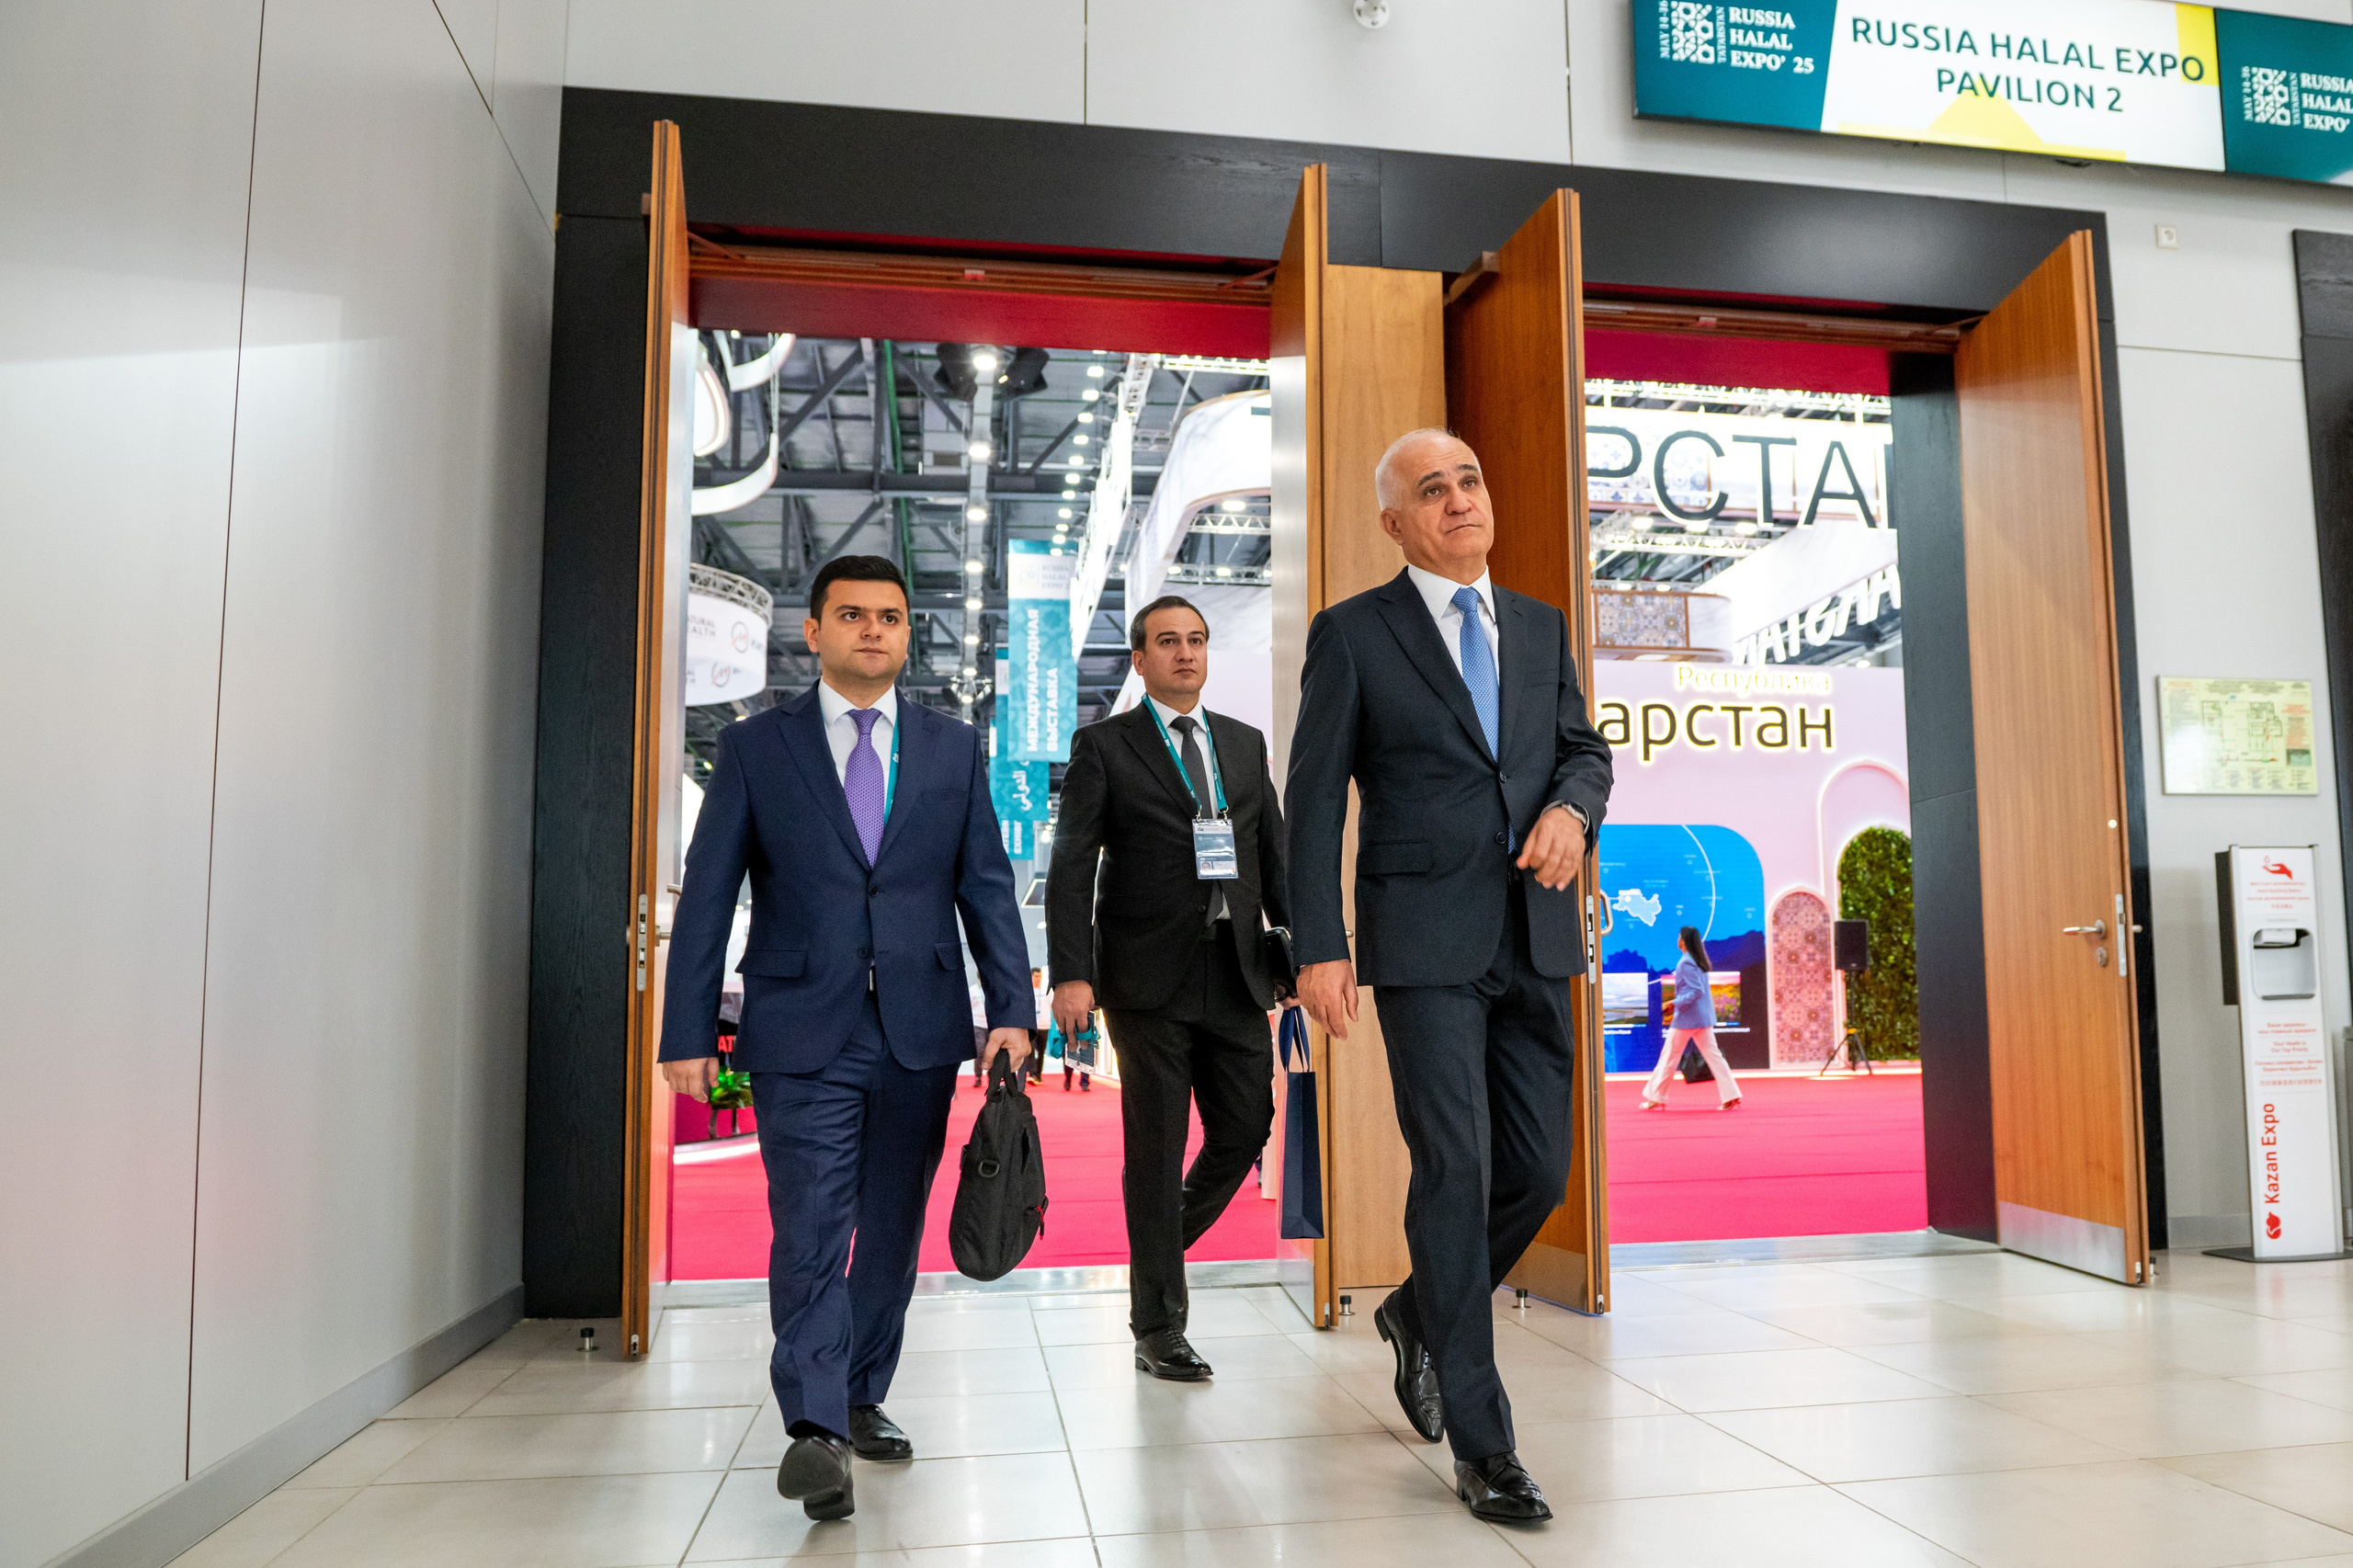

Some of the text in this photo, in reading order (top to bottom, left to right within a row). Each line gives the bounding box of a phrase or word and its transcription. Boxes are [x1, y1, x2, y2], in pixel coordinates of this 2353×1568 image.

[1715, 6, 1727, 63] TATARSTAN
[1729, 6, 1796, 29] RUSSIA
[1730, 28, 1793, 51] HALAL
[1659, 31, 1670, 60] MAY
[1792, 56, 1815, 75] 25
[1852, 17, 2205, 82] RUSSIA HALAL EXPO
[1937, 68, 2124, 112] PAVILION 2
[2302, 93, 2353, 114] HALAL
[1586, 425, 1894, 529] РСТА
[1027, 608, 1040, 752] МЕЖДУНАРОДНАЯ
[1678, 666, 1830, 696] Республика
[1047, 667, 1058, 752] ВЫСТАВКА
[2261, 1103, 2280, 1203] Kazan Expo
